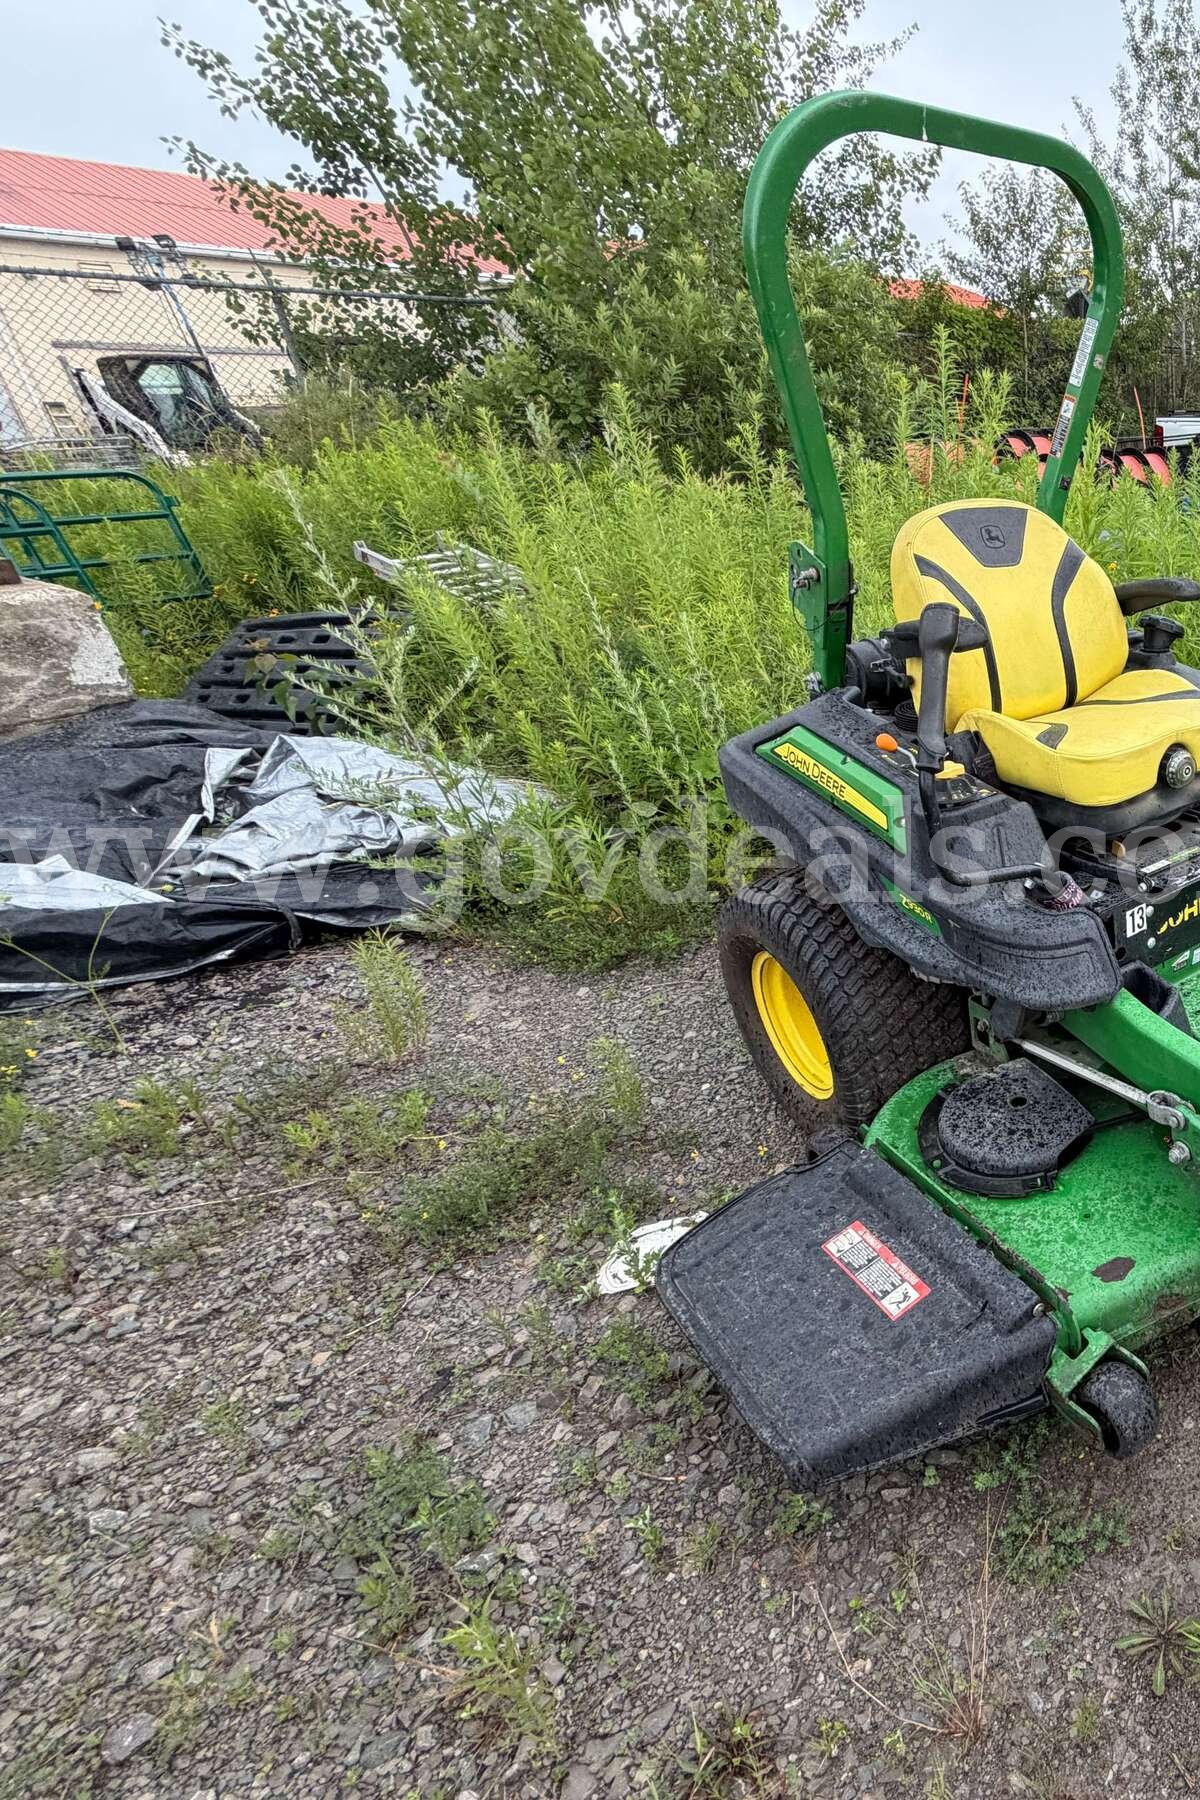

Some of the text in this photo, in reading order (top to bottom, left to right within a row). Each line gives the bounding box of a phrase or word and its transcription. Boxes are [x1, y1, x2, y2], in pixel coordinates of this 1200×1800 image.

[782, 746, 847, 797] JOHN DEERE
[1128, 906, 1146, 934] 13
